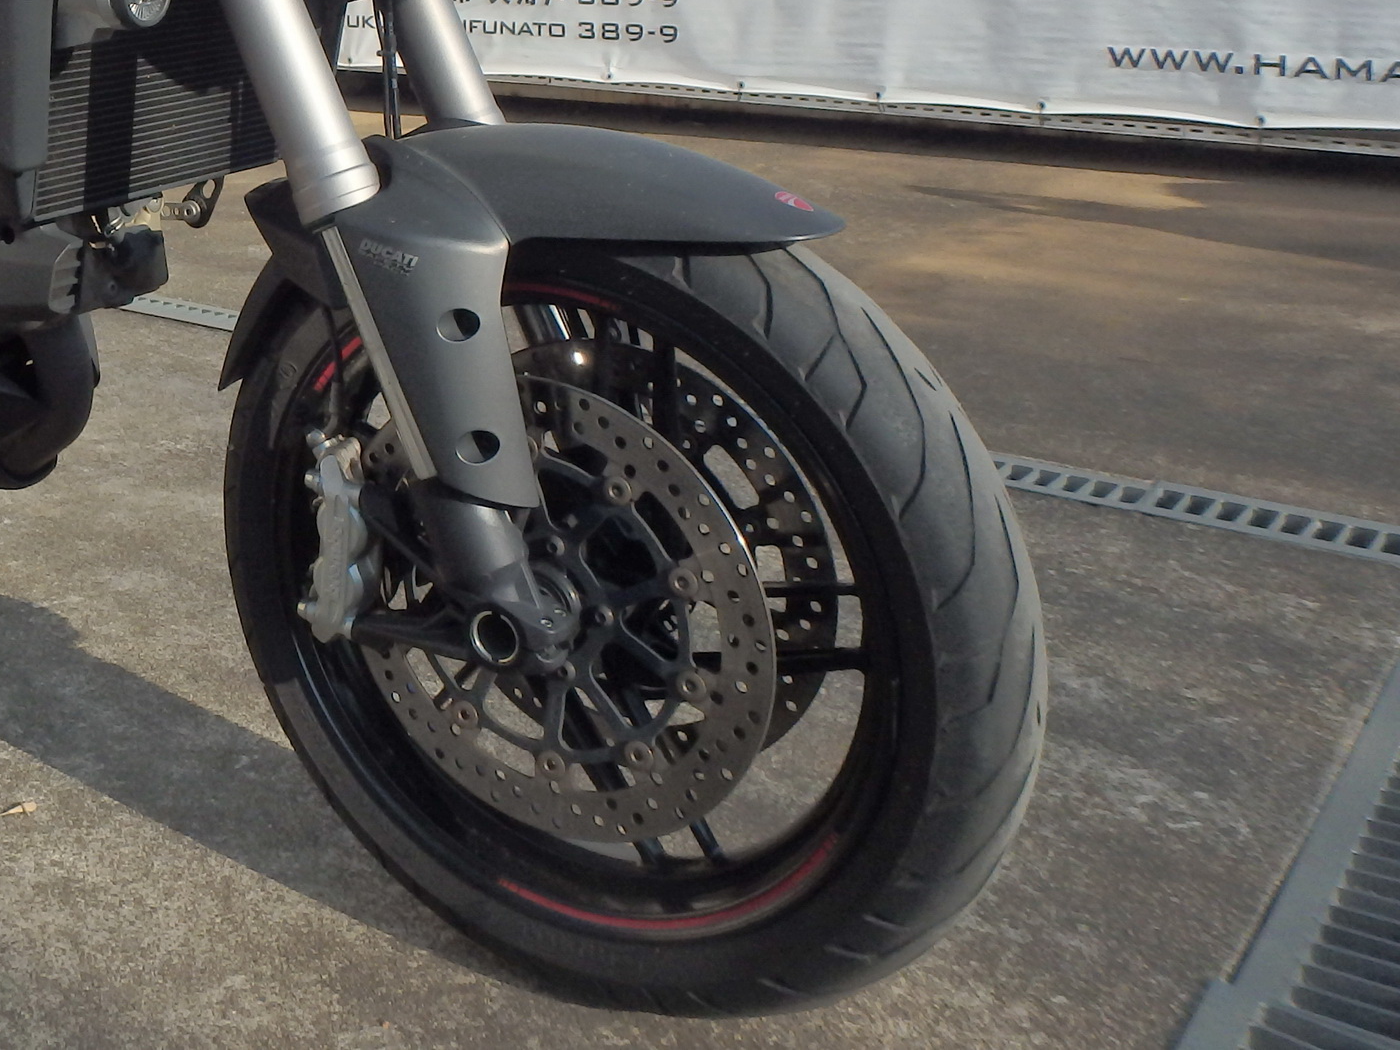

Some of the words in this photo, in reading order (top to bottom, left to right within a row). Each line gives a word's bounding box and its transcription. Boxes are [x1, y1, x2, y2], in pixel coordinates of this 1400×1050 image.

[463, 19, 566, 38] FUNATO
[577, 21, 679, 44] 389-9
[360, 238, 419, 267] DUCATI
